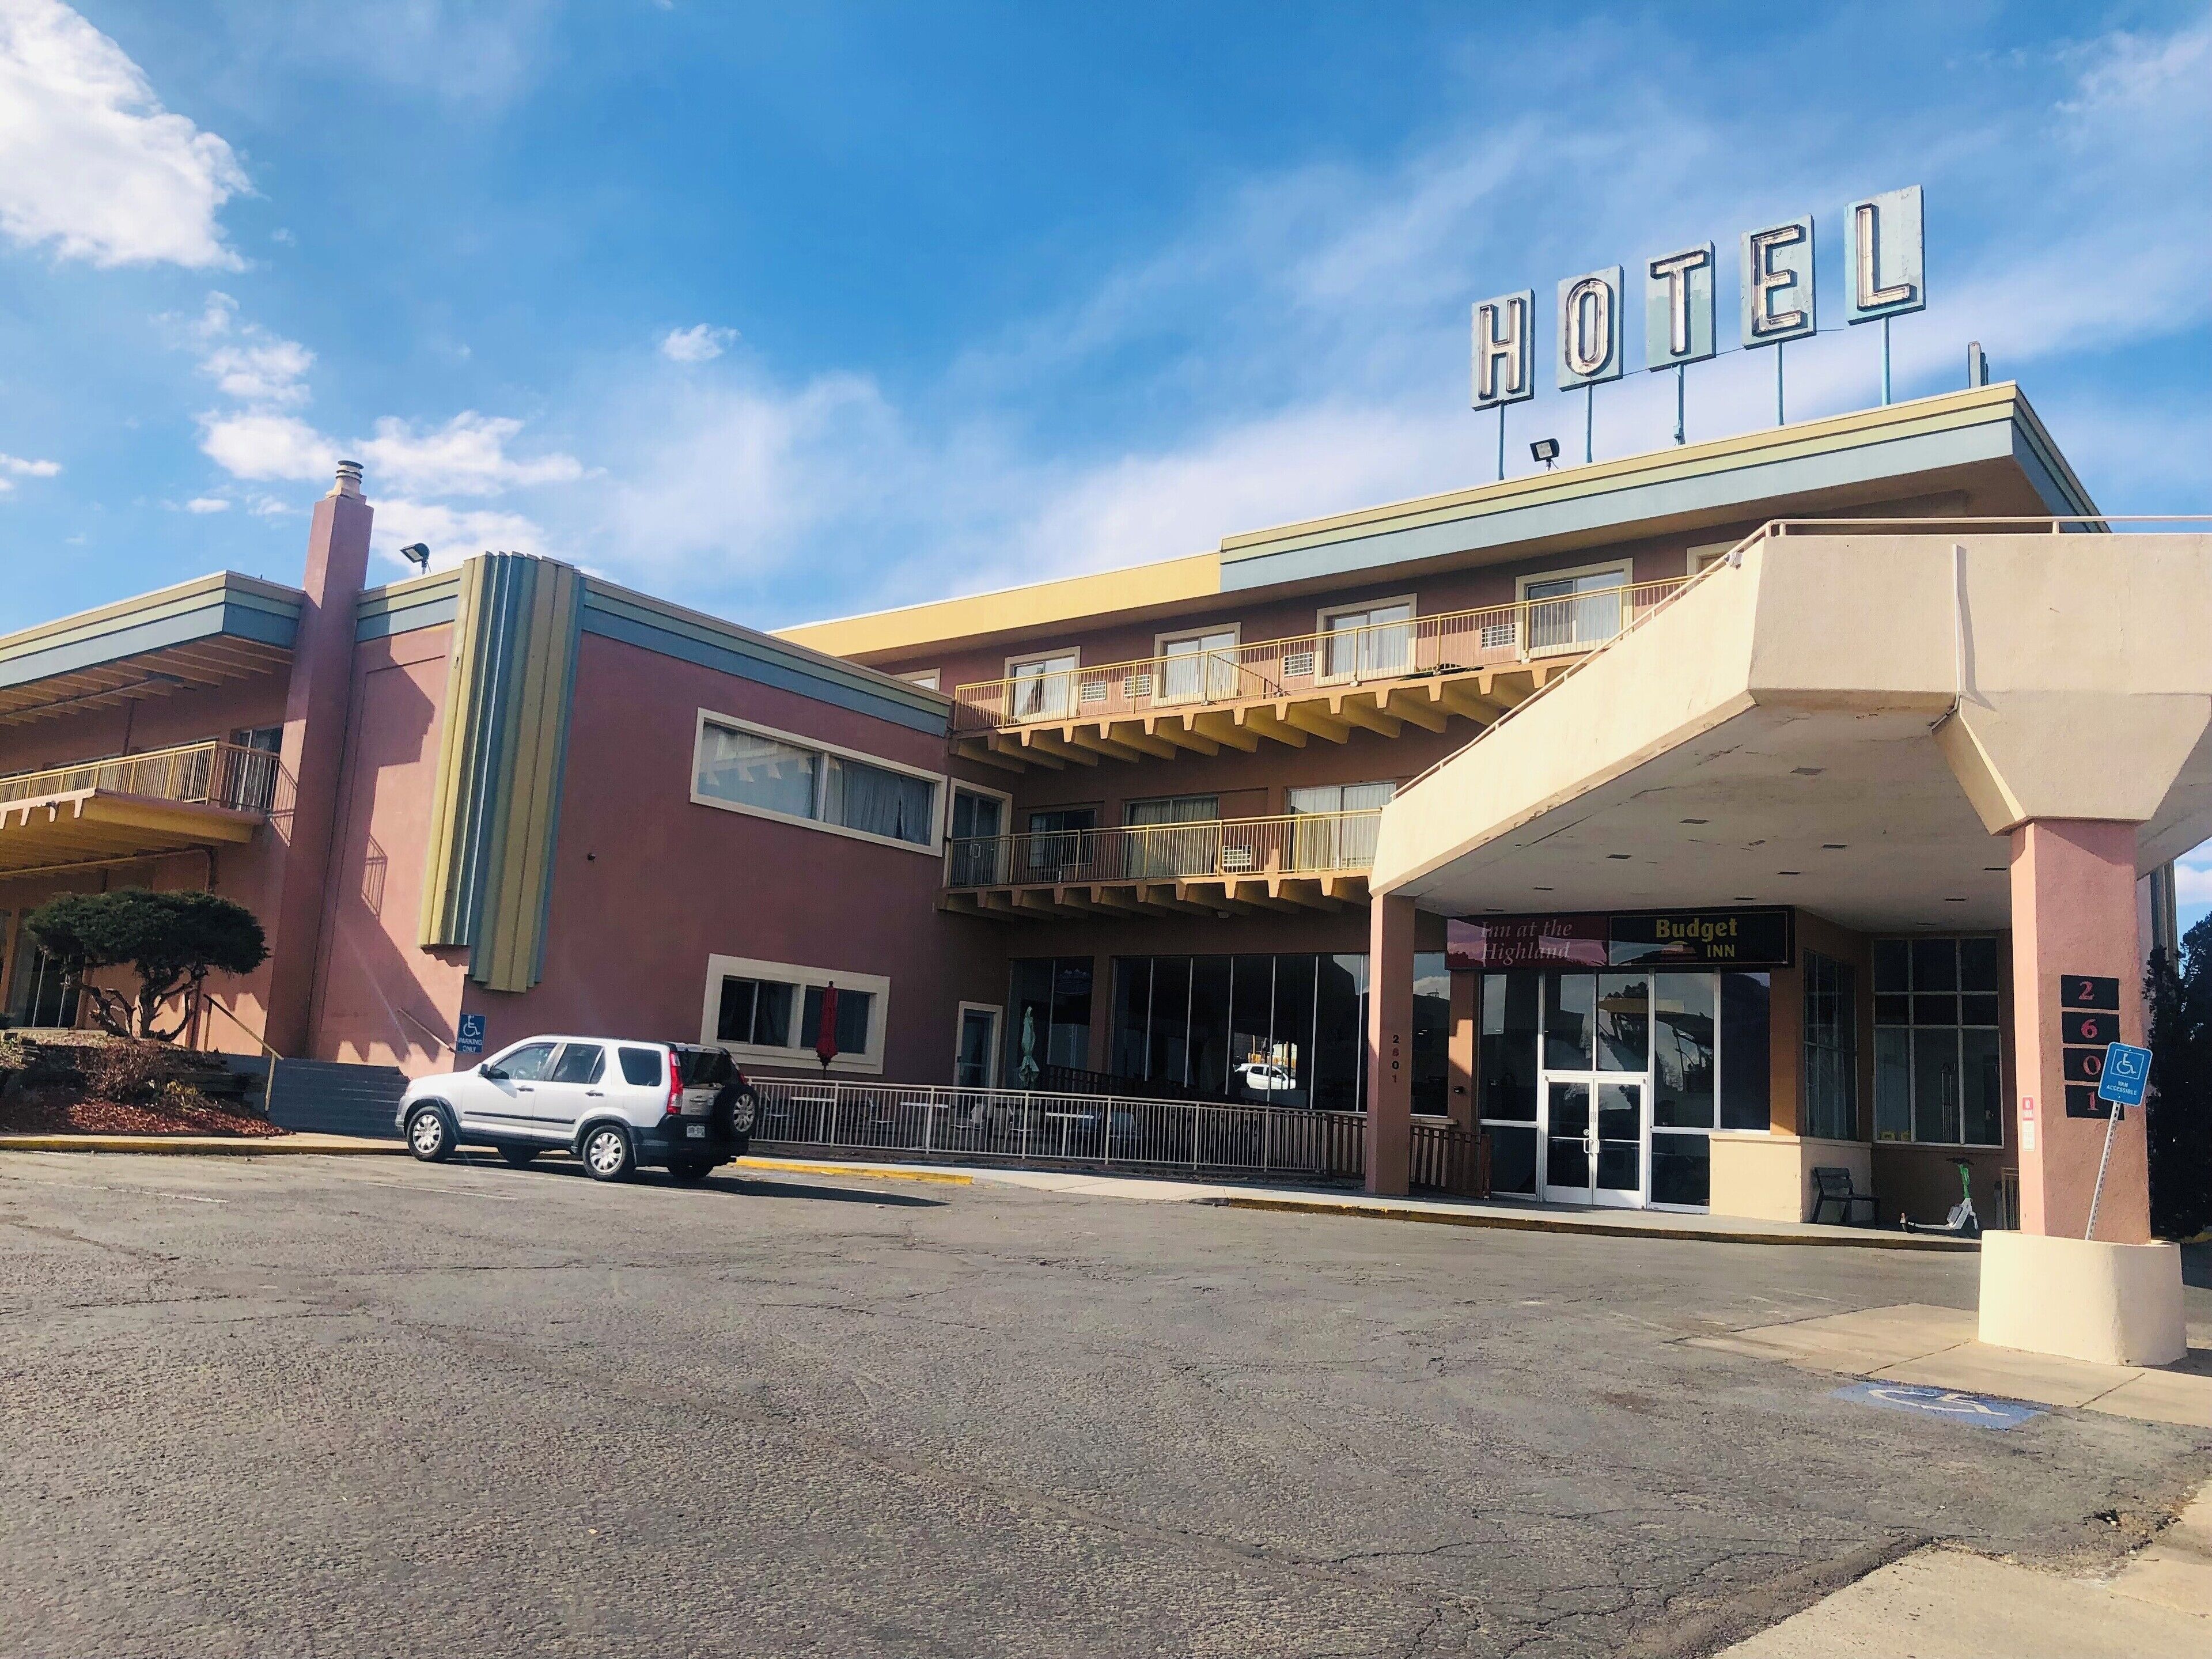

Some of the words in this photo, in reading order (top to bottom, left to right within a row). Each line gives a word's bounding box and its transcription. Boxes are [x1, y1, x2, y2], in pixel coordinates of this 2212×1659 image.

[1478, 203, 1918, 399] HOTEL
[1481, 921, 1510, 938] Inn
[1517, 922, 1537, 937] at
[1543, 919, 1573, 937] the
[1656, 918, 1737, 942] Budget
[1481, 941, 1571, 965] Highland
[1707, 944, 1735, 957] INN
[2106, 1085, 2138, 1096] ACCESSIBLE
